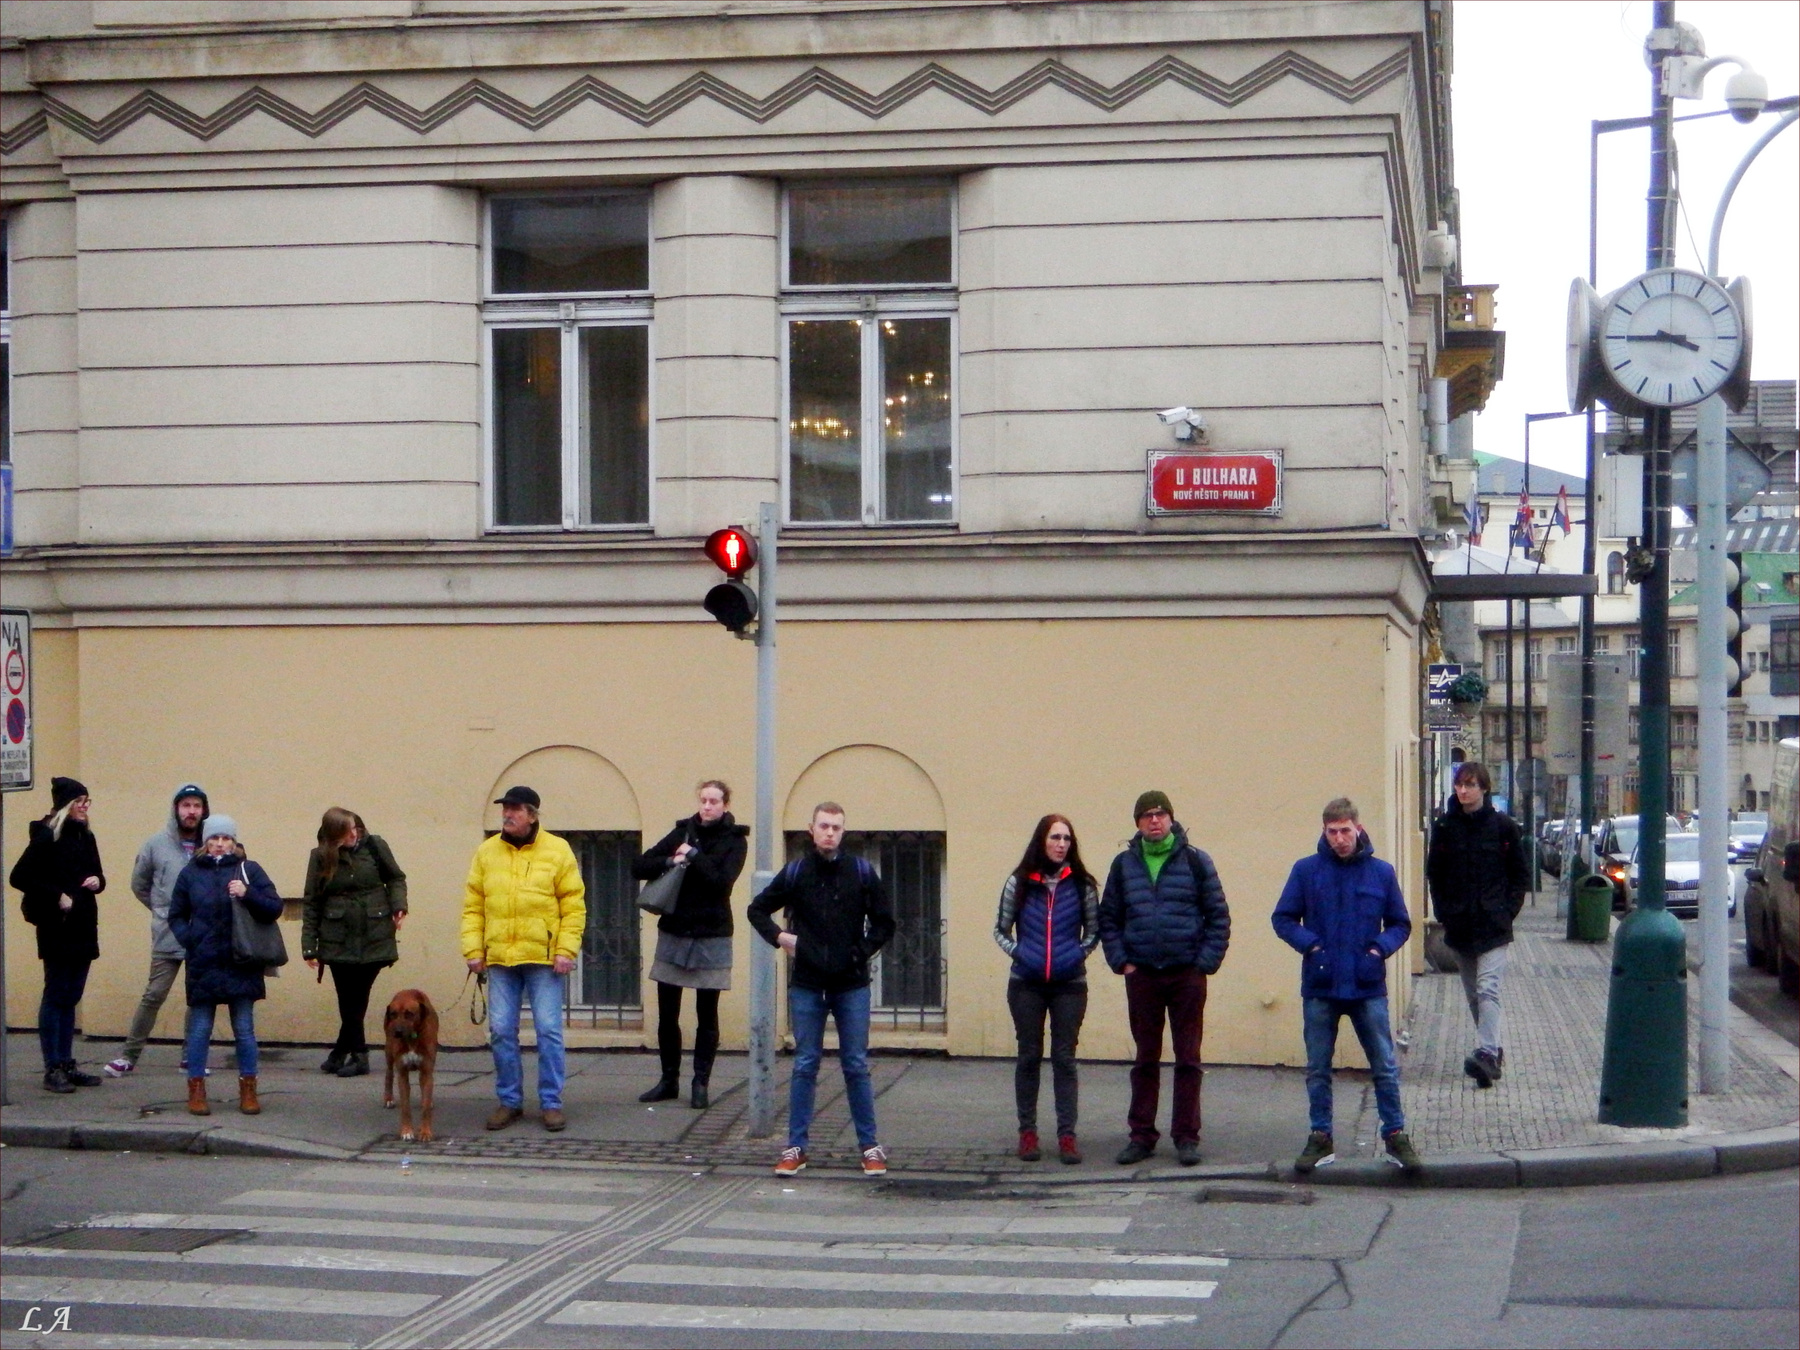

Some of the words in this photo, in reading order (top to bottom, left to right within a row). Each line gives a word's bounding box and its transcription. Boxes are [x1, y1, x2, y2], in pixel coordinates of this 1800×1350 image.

[1176, 468, 1184, 485] U
[1192, 467, 1258, 485] BULHARA
[1173, 488, 1193, 500] NOVÉ
[1194, 487, 1219, 500] MĚSTO
[1222, 490, 1249, 500] PRAHA
